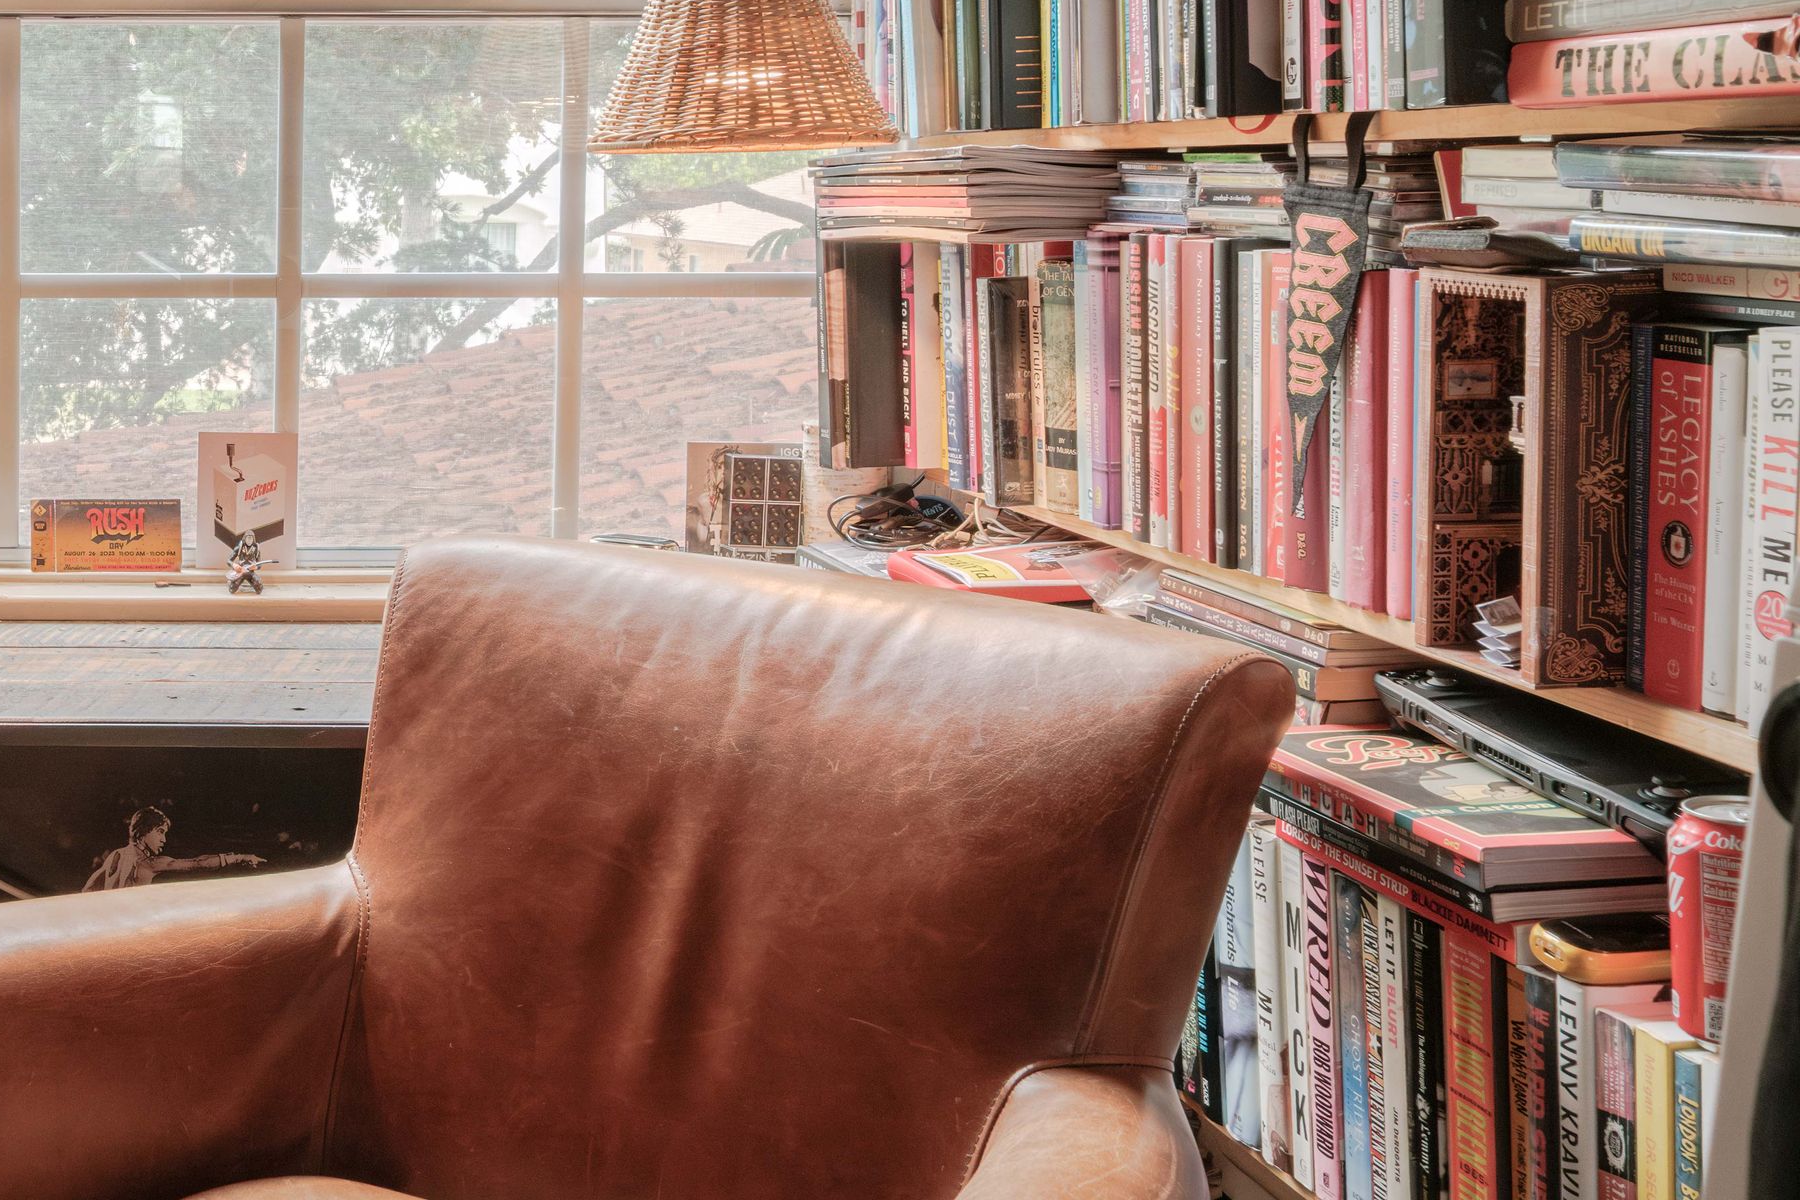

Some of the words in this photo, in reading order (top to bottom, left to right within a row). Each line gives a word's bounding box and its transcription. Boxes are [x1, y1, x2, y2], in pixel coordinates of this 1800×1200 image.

[1554, 42, 1652, 98] THE
[1670, 32, 1800, 90] CLA
[901, 300, 908, 316] TO
[1214, 279, 1222, 340] BROTHERS
[1288, 212, 1359, 396] CREEM
[1671, 272, 1694, 283] NICO
[1696, 273, 1736, 286] WALKER
[1032, 305, 1042, 345] brain
[1148, 278, 1160, 394] UNSCREWED
[902, 358, 910, 384] AND
[1034, 348, 1042, 390] rules
[1662, 370, 1678, 396] of
[1770, 340, 1794, 423] PLEASE
[1657, 404, 1678, 506] ASHES
[1680, 372, 1702, 516] LEGACY
[244, 479, 278, 502] BUZZCOCKS
[86, 507, 146, 538] RUSH
[1762, 536, 1792, 586] ME
[1281, 821, 1308, 845] LORDS
[1310, 836, 1322, 850] OF
[1324, 842, 1341, 862] THE
[1342, 849, 1378, 882] SUNSET
[1380, 870, 1410, 897] STRIP
[1410, 890, 1454, 922] BLACKIE
[1455, 914, 1508, 951] DAMMETT
[1304, 858, 1331, 1030] WIRED
[1384, 916, 1395, 954] LET
[1386, 958, 1396, 980] IT
[1286, 902, 1308, 1142] MICK
[1386, 983, 1398, 1048] BLURT
[1560, 994, 1578, 1100] LENNY
[1312, 1036, 1332, 1070] BOB
[1314, 1072, 1334, 1160] WOODWARD
[1560, 1105, 1579, 1200] KRAVI
